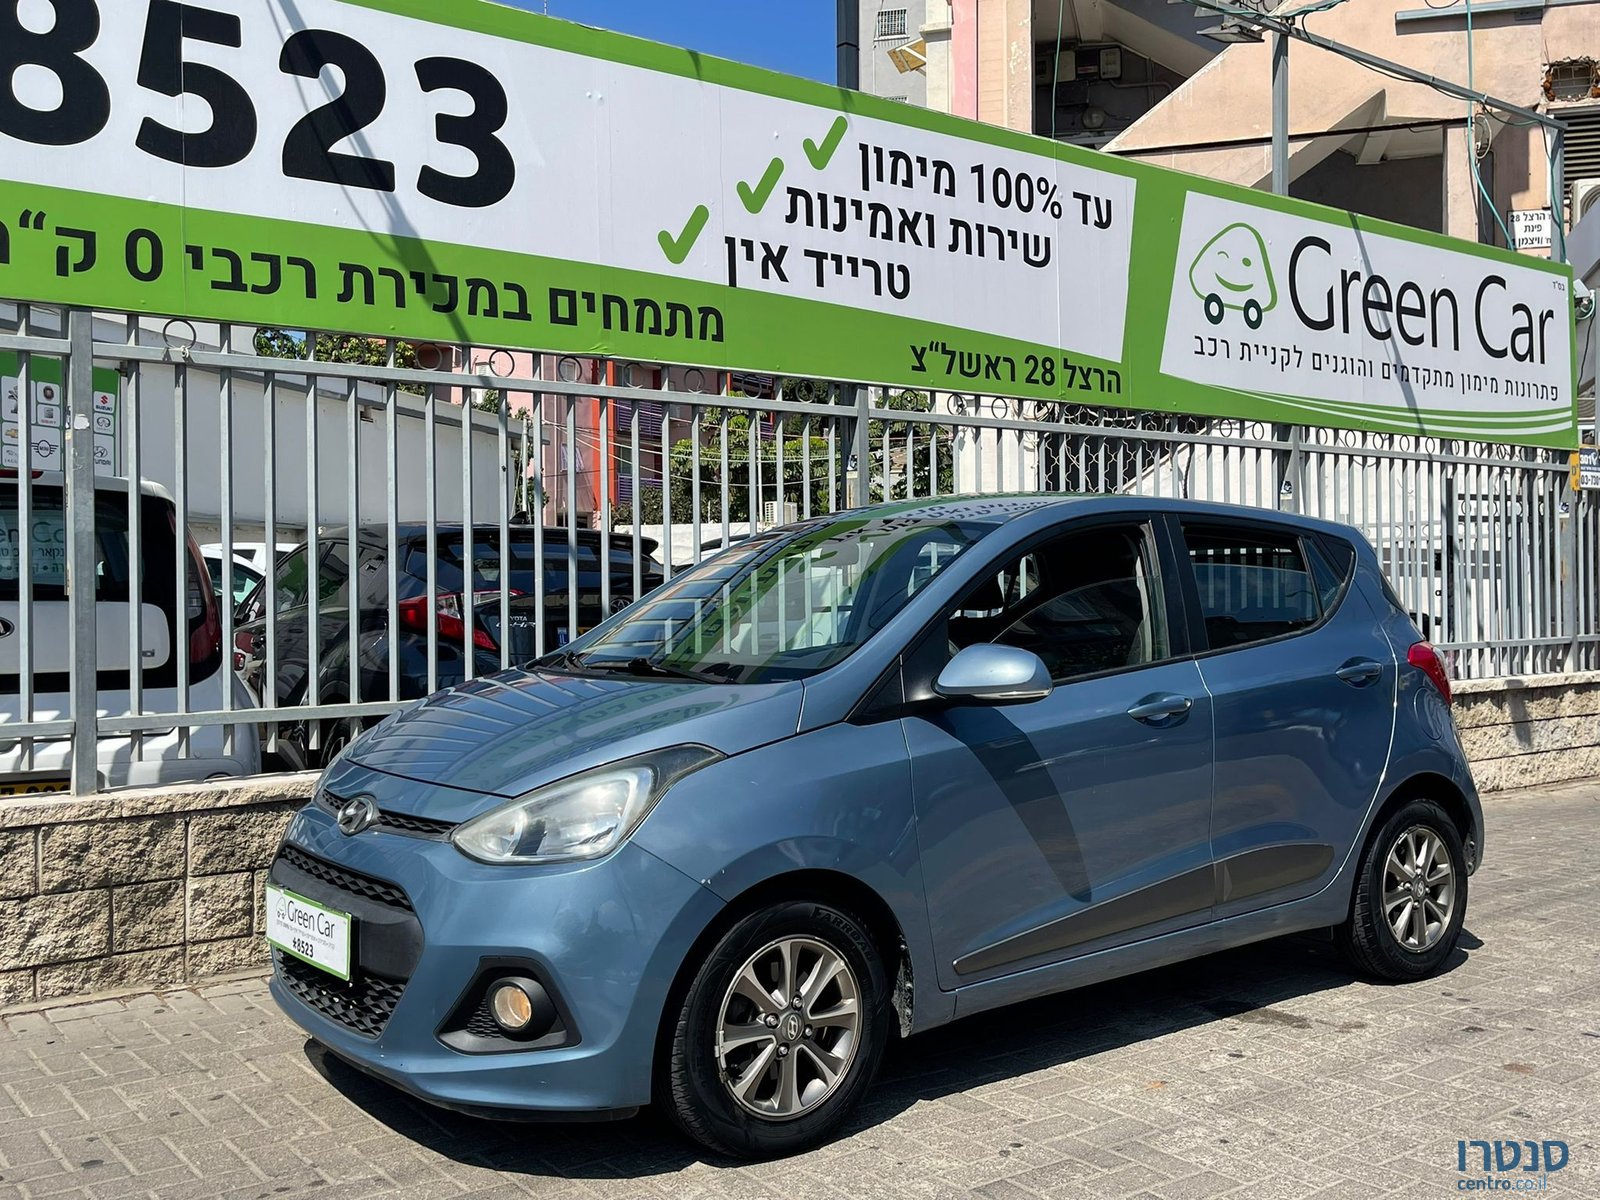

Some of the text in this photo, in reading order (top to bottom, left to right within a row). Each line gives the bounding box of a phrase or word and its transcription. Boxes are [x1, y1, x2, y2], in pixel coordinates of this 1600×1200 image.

[0, 0, 515, 207] 8523
[858, 142, 1113, 229] עד 100% מימון
[785, 185, 1051, 268] שירות ואמינות
[1510, 214, 1520, 223] 28
[1523, 212, 1546, 221] הרצל
[1523, 224, 1542, 233] פינת
[125, 228, 163, 282] 0
[185, 244, 316, 299] רכבי
[724, 236, 911, 300] טרייד אין
[337, 262, 532, 322] במכירת
[549, 287, 724, 343] מתמחים
[1288, 235, 1555, 365] Green Car
[910, 340, 1122, 394] הרצל 28 ראשל"צ
[1194, 335, 1558, 402] פתרונות מימון מתקדמים והוגנים לקניית רכב
[287, 900, 315, 932] Green
[317, 912, 335, 939] Car
